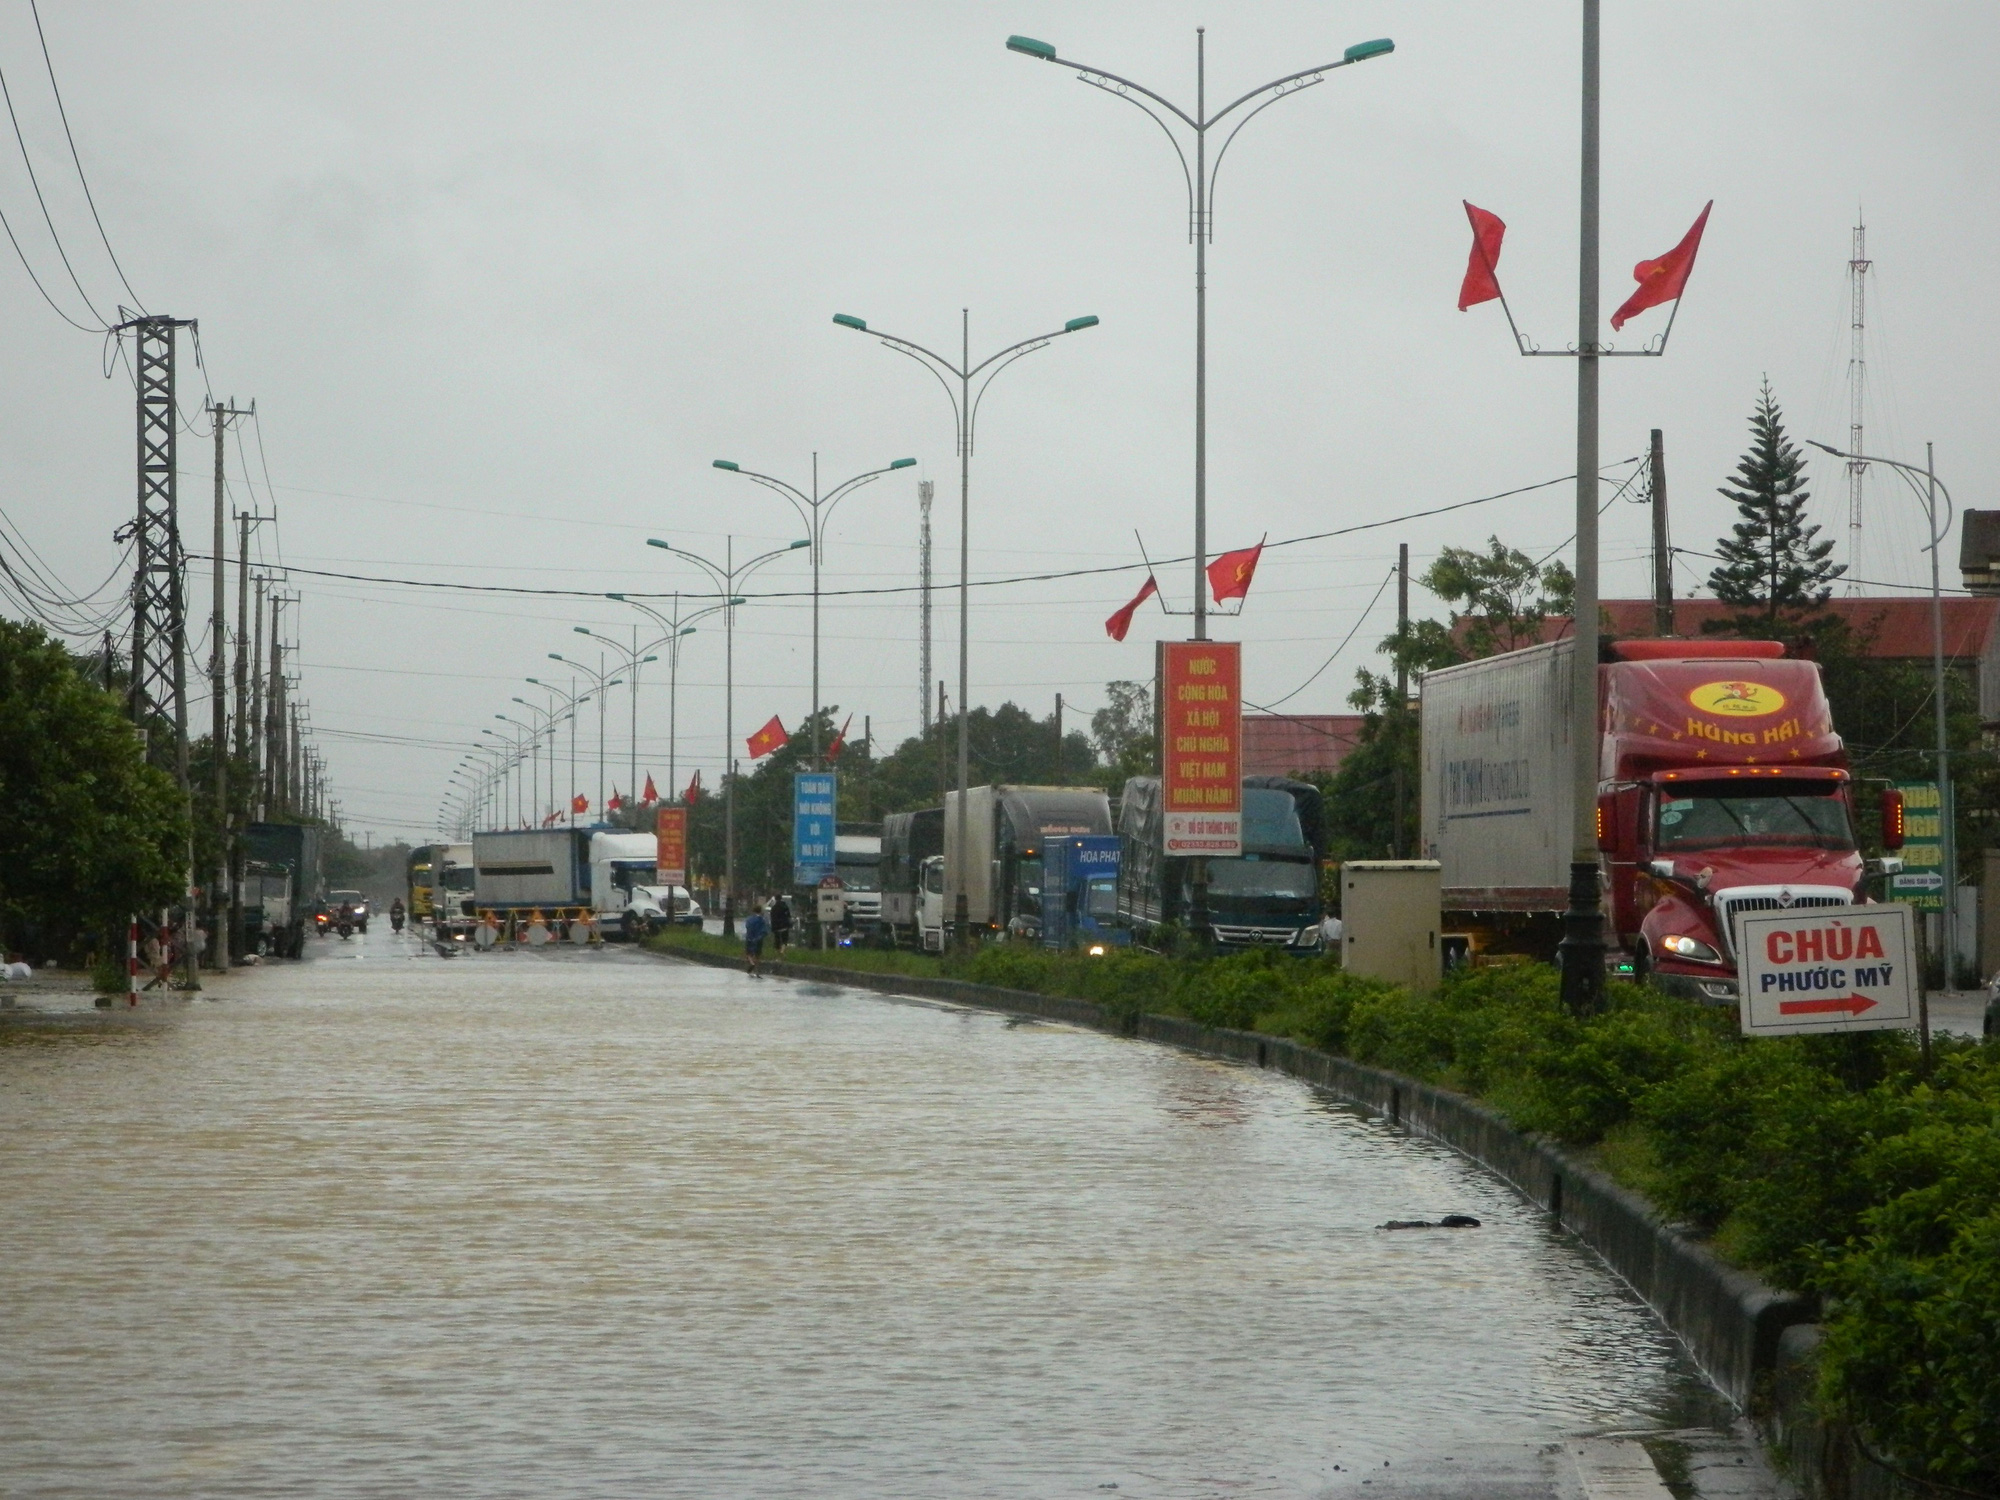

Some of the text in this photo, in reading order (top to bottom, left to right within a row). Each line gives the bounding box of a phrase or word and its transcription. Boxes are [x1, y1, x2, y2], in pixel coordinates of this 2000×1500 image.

[1189, 656, 1217, 675] NƯỚC
[1178, 682, 1228, 704] CỘNG HÒA
[1186, 708, 1220, 730] XÃ HỘI
[1176, 732, 1230, 752] CHỦ NGHĨA
[1687, 717, 1756, 745] HÙNG
[1179, 759, 1227, 781] VIỆT NAM
[1173, 785, 1203, 804] MUÔN
[1898, 782, 1941, 808] NHÀ
[1766, 920, 1885, 965] CHÙA
[1760, 963, 1894, 993] PHƯỚC MỸ
